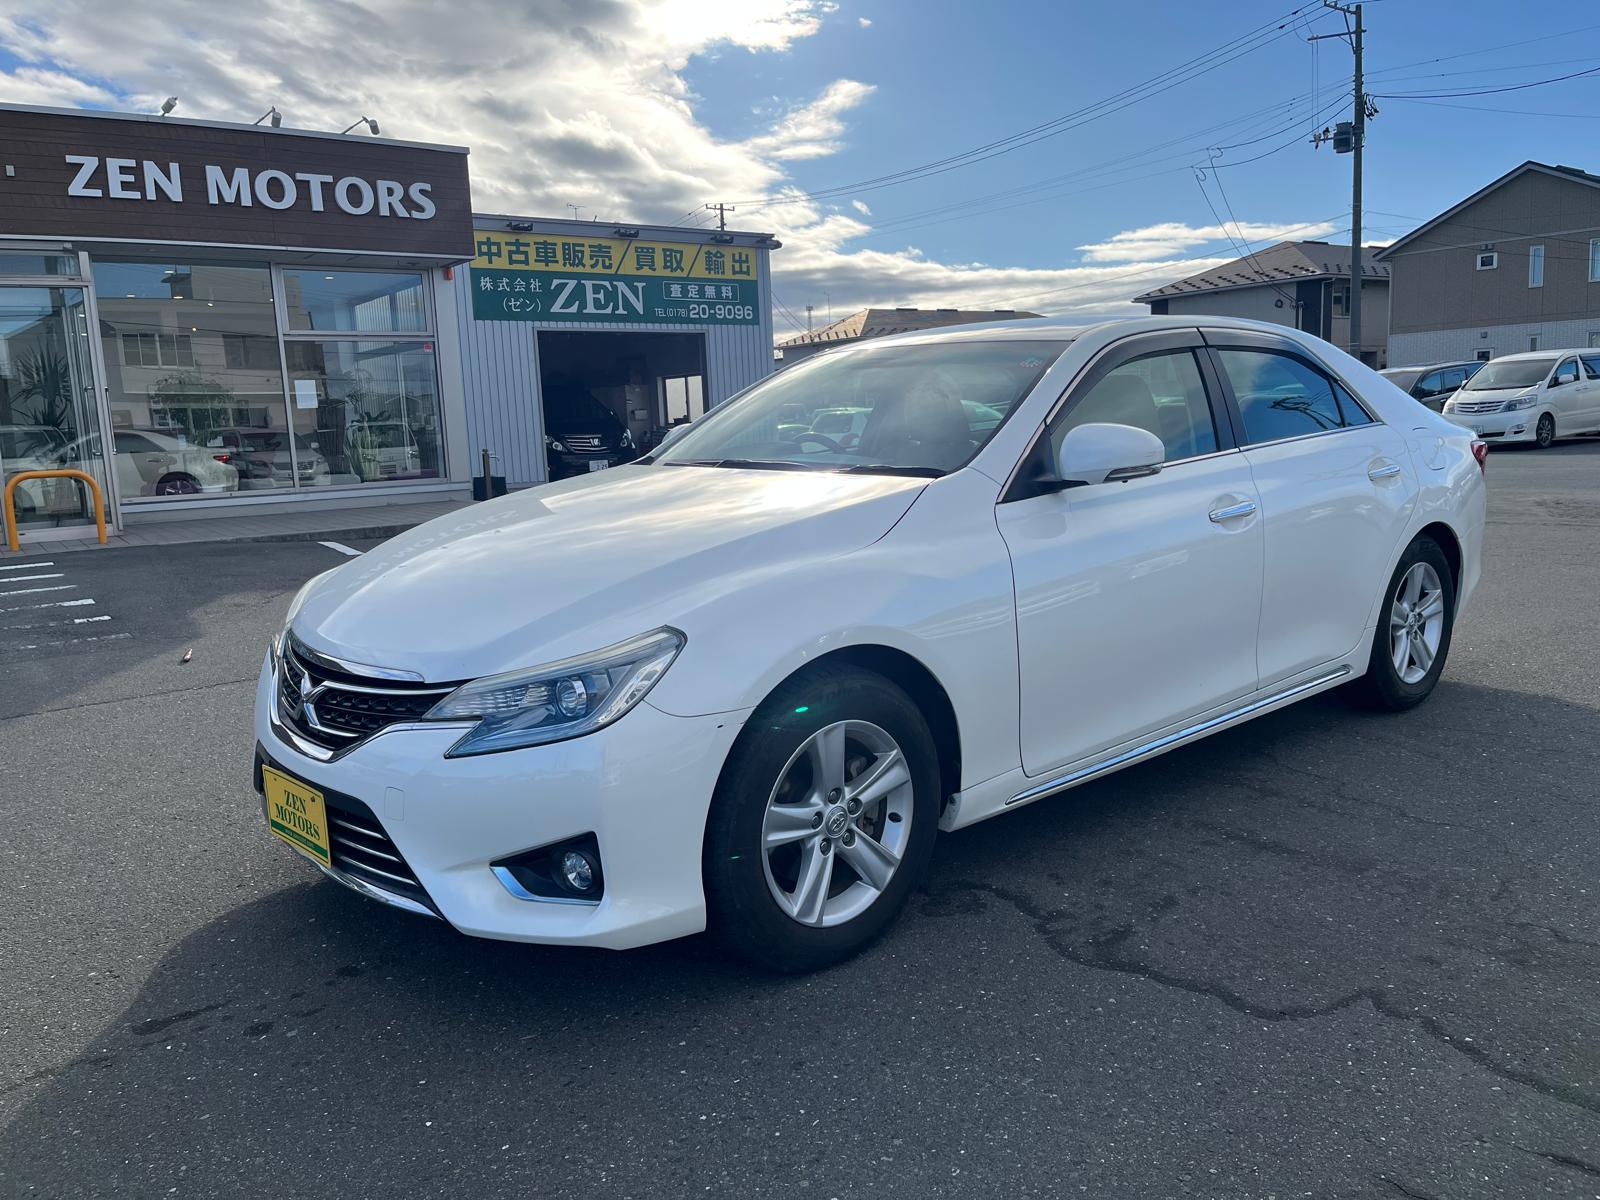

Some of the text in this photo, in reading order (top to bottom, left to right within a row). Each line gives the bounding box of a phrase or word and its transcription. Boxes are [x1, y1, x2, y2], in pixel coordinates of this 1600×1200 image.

[65, 154, 436, 220] ZEN MOTORS
[480, 276, 543, 293] 株式会社
[550, 278, 647, 315] ZEN
[669, 283, 733, 299] 査定無料
[689, 303, 753, 320] 20-9096
[285, 790, 307, 815] ZEN
[275, 803, 321, 841] MOTORS
